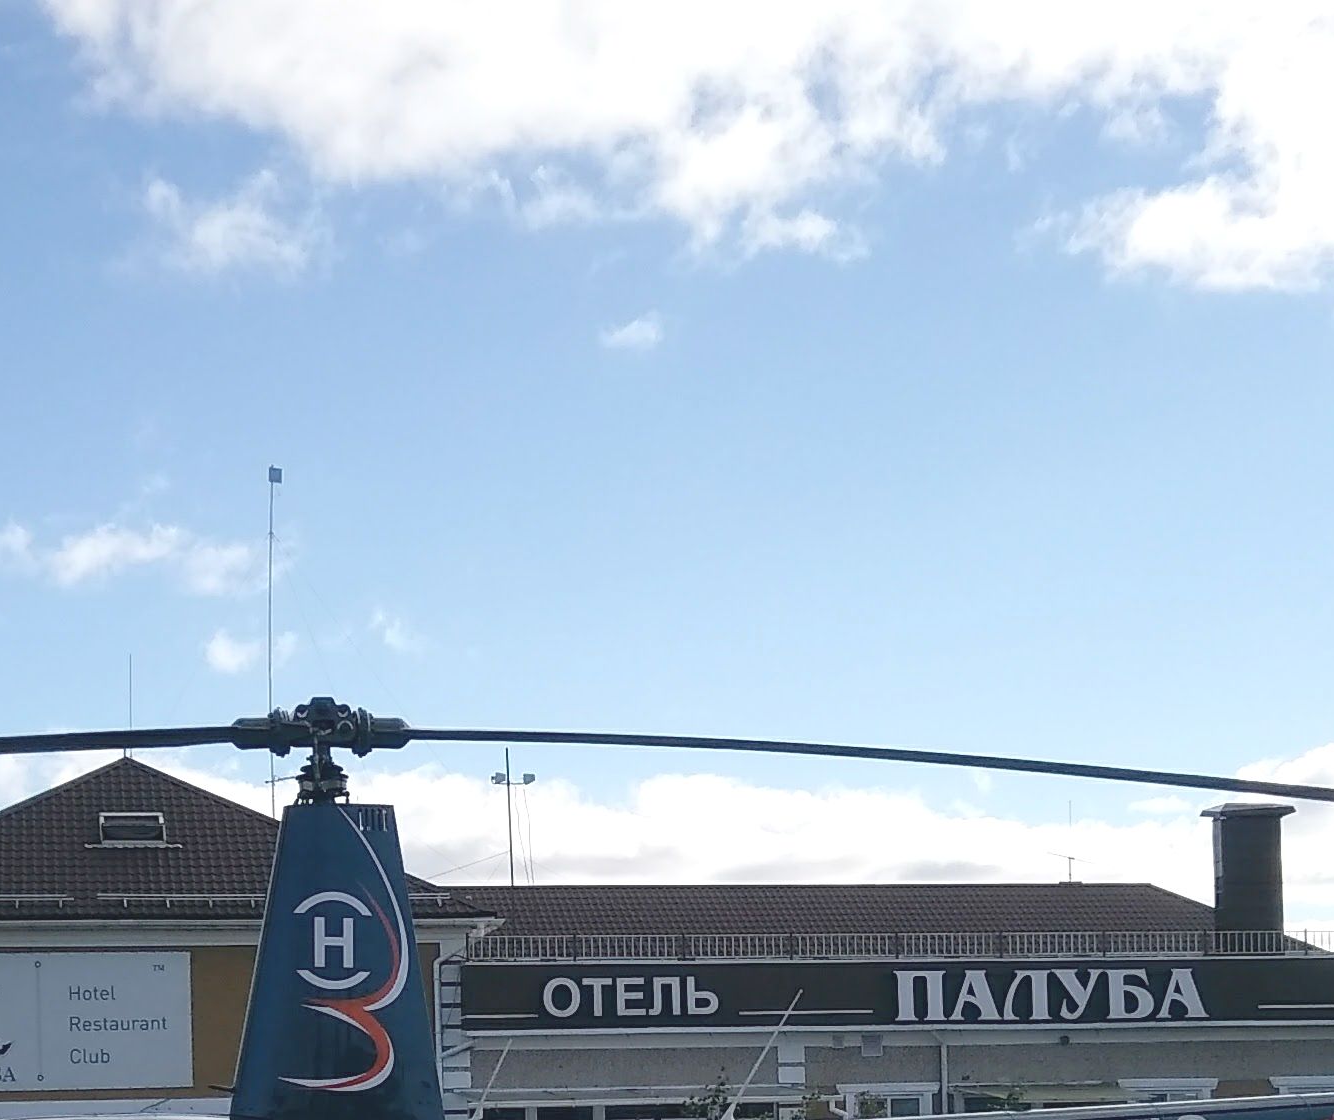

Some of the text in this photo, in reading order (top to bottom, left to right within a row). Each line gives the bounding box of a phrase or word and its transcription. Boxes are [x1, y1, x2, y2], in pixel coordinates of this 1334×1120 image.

[69, 986, 116, 1001] Hotel
[543, 976, 719, 1018] ОТЕЛЬ
[893, 968, 1210, 1021] ПАЛУБА
[69, 1016, 168, 1032] Restaurant
[70, 1050, 110, 1064] Club
